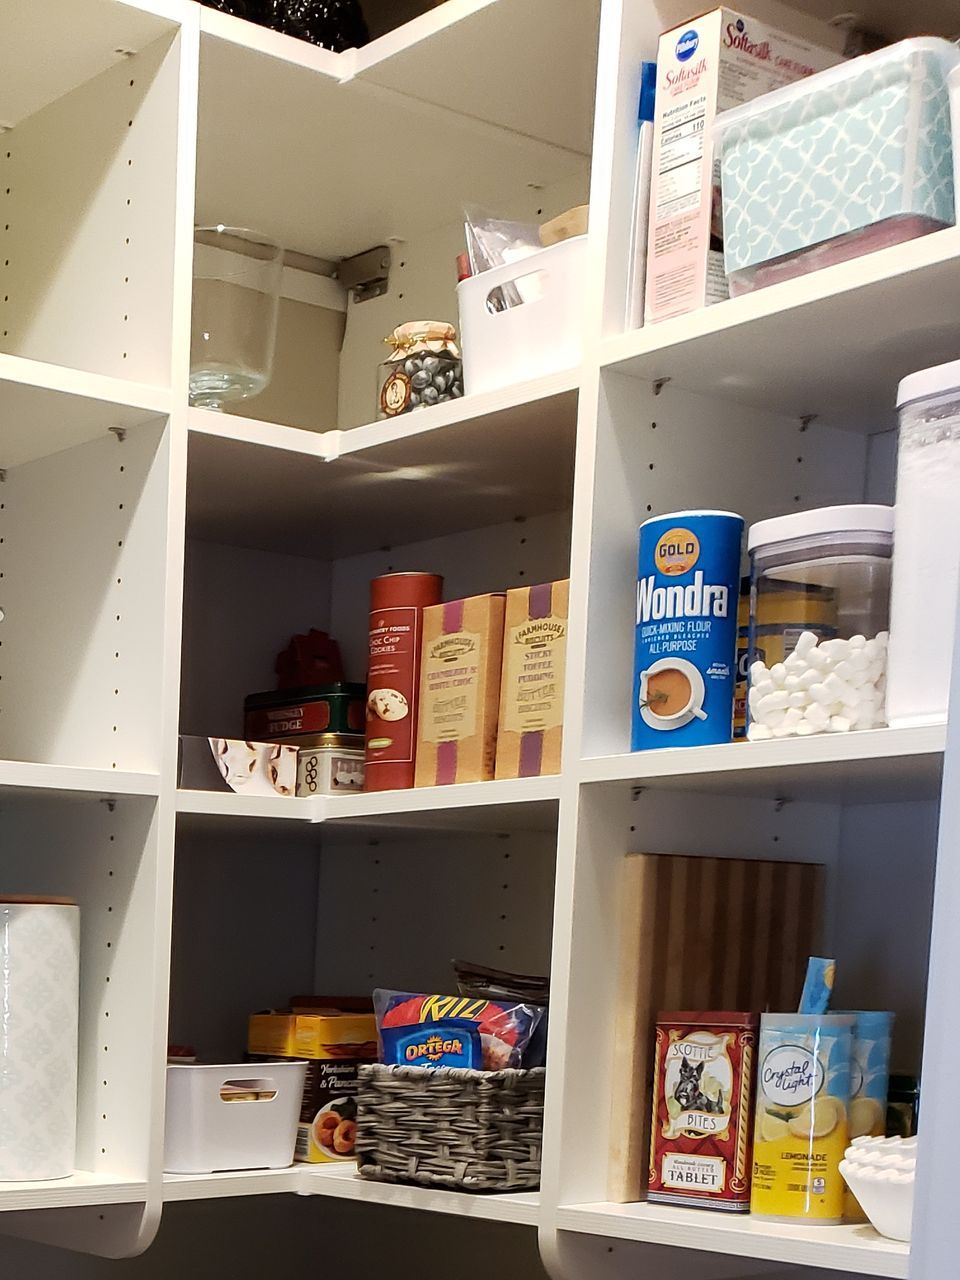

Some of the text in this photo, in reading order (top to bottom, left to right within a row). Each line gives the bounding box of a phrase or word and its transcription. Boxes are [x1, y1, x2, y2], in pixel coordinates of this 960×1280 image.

[723, 23, 771, 61] Softasilk
[663, 58, 707, 90] Softasilk
[659, 542, 695, 558] GOLD
[636, 570, 729, 625] Wondra
[517, 623, 562, 639] FARMHOUSE
[642, 621, 712, 638] QUICK-MIXING FLOUR
[649, 639, 697, 655] ALL-PURPOSE
[270, 720, 303, 732] FUDGE
[405, 1038, 463, 1061] ORTEGA
[672, 1043, 714, 1060] SCOTTIE
[764, 1060, 810, 1087] Crystal
[687, 1113, 717, 1131] BITES
[781, 1152, 828, 1162] LEMONADE
[668, 1169, 718, 1186] TABLET
